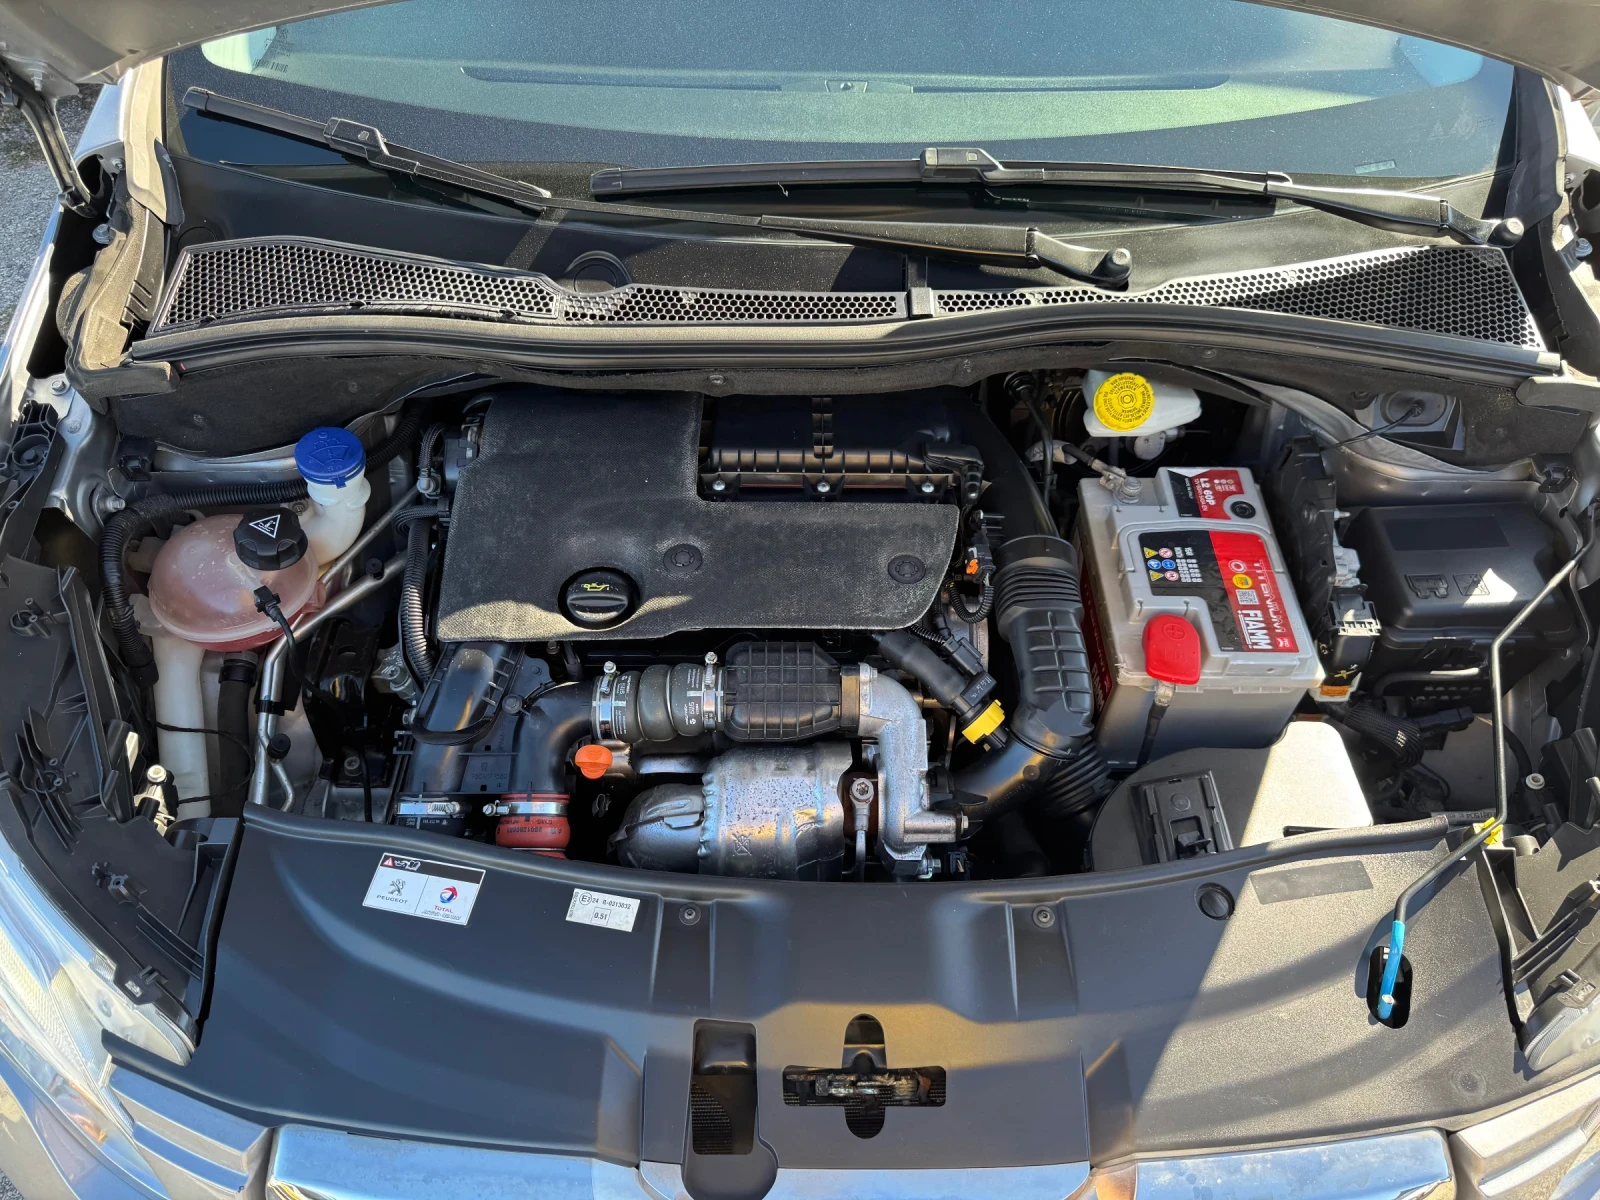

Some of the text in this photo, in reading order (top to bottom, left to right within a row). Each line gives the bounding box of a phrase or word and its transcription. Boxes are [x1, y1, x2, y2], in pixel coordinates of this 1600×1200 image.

[1200, 478, 1217, 506] L2 60P
[1245, 610, 1273, 650] FIAMM
[376, 895, 408, 904] PEUGEOT
[434, 905, 454, 913] TOTAL
